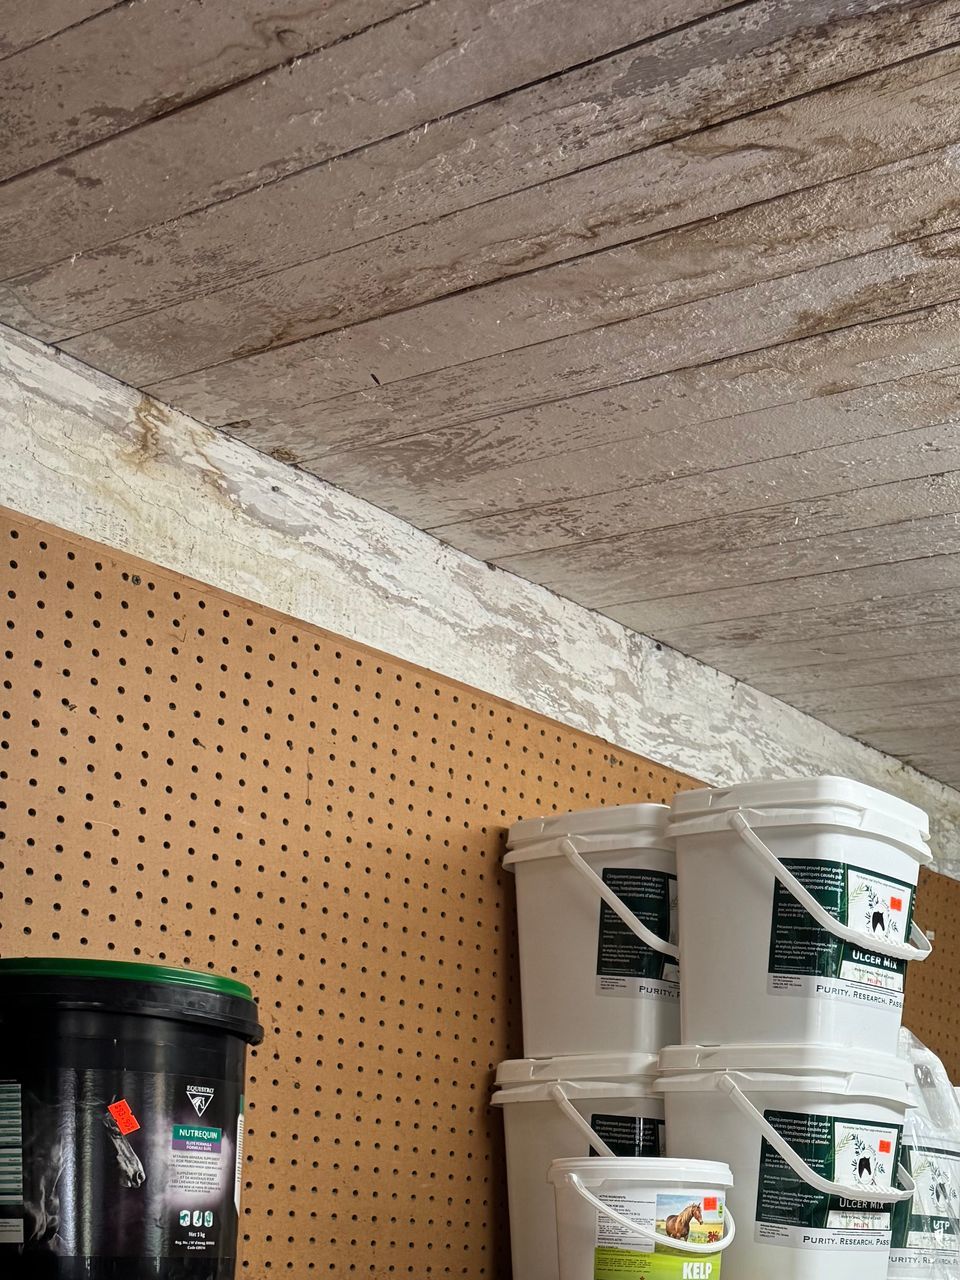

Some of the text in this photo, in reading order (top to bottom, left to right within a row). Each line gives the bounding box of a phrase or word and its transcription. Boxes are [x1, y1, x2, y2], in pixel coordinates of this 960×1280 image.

[852, 949, 882, 966] ULCER
[816, 984, 850, 997] PURITY.
[853, 990, 888, 1005] RESEARCH.
[179, 1128, 218, 1140] NUTREQUIN
[840, 1198, 868, 1209] ULCER
[802, 1236, 838, 1245] PURITY.
[839, 1237, 874, 1246] RESEARCH.
[682, 1262, 712, 1280] KELP
